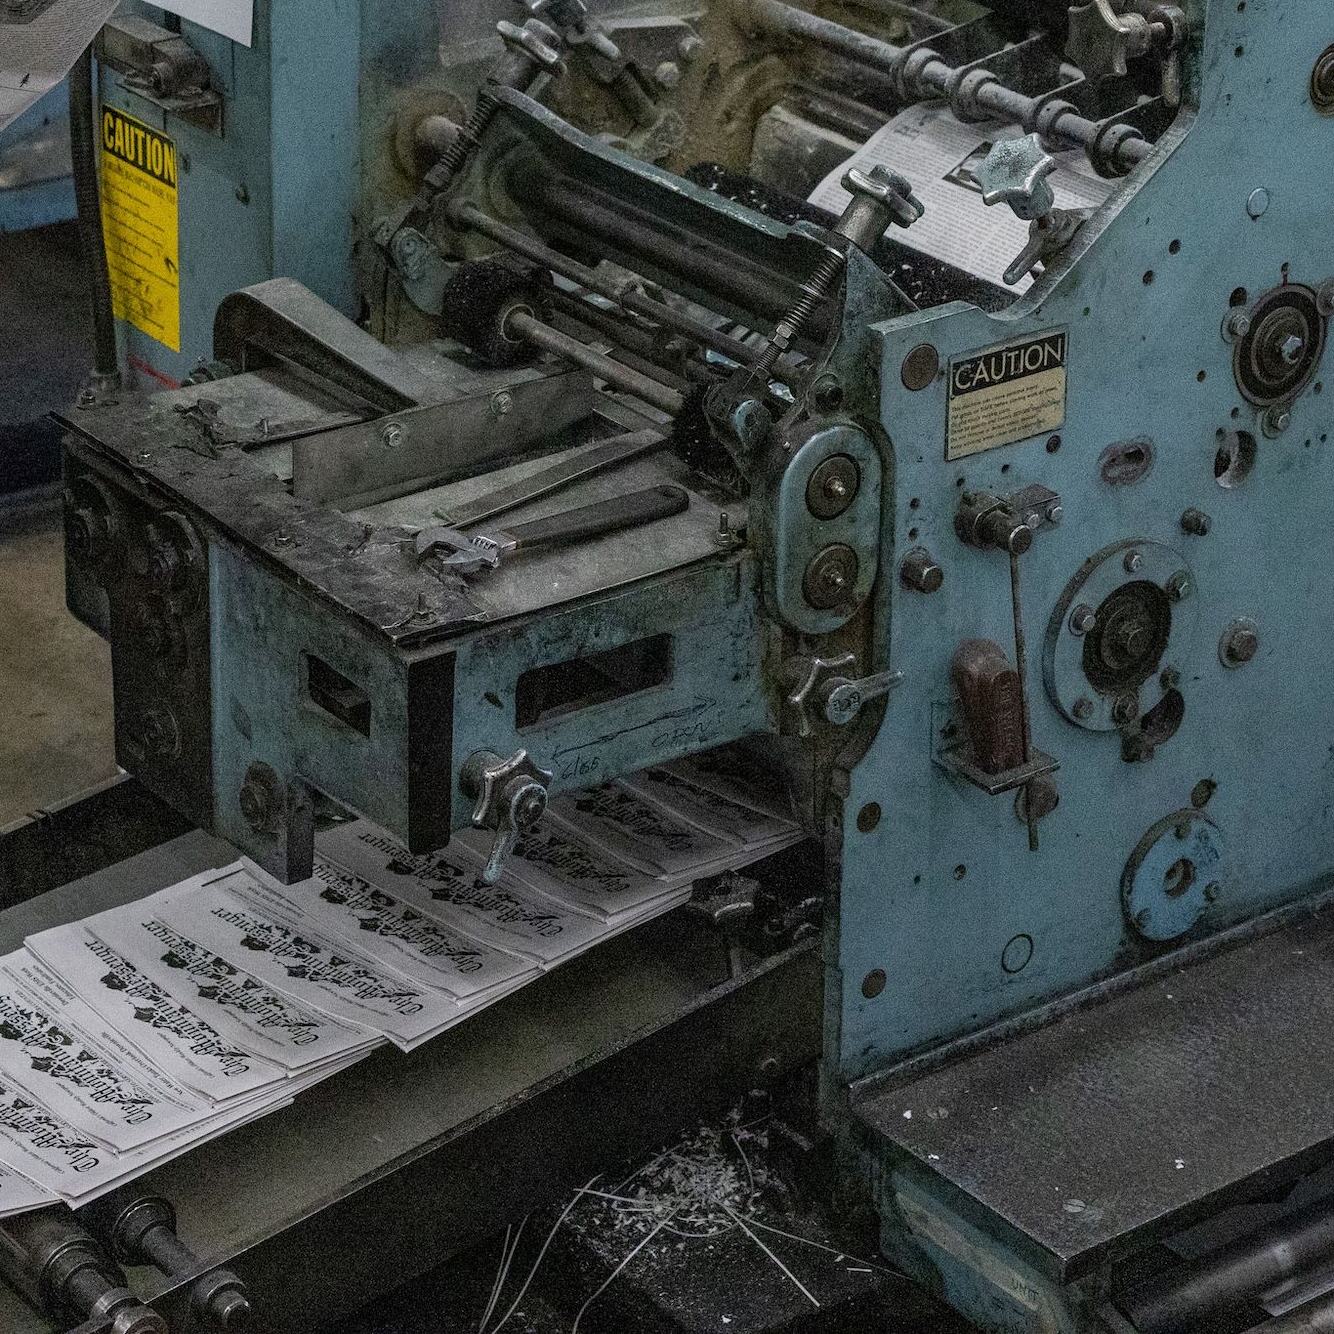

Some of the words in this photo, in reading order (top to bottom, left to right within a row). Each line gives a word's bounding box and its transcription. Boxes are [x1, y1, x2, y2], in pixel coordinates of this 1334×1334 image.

[104, 112, 175, 184] CAUTION
[954, 338, 1062, 390] CAUTION
[210, 906, 298, 952] Messenger
[376, 908, 452, 952] Mountain
[140, 918, 219, 969] Messenger
[83, 938, 153, 995] Messenger
[450, 951, 482, 972] The
[30, 974, 45, 987] EMS
[300, 954, 386, 995] Mountain
[40, 982, 71, 1007] Downieville
[215, 974, 290, 1023] Mountain
[394, 995, 423, 1013] The
[151, 995, 222, 1052] Mountain
[286, 1020, 319, 1043] The
[97, 1029, 128, 1054] Downieville
[49, 1045, 125, 1098] Mountain
[123, 1049, 147, 1069] Overlook
[145, 1064, 162, 1079] Tanks
[218, 1053, 249, 1075] The
[158, 1074, 175, 1089] Water
[172, 1084, 185, 1096] New
[120, 1099, 152, 1123] The
[64, 1143, 99, 1173] The
